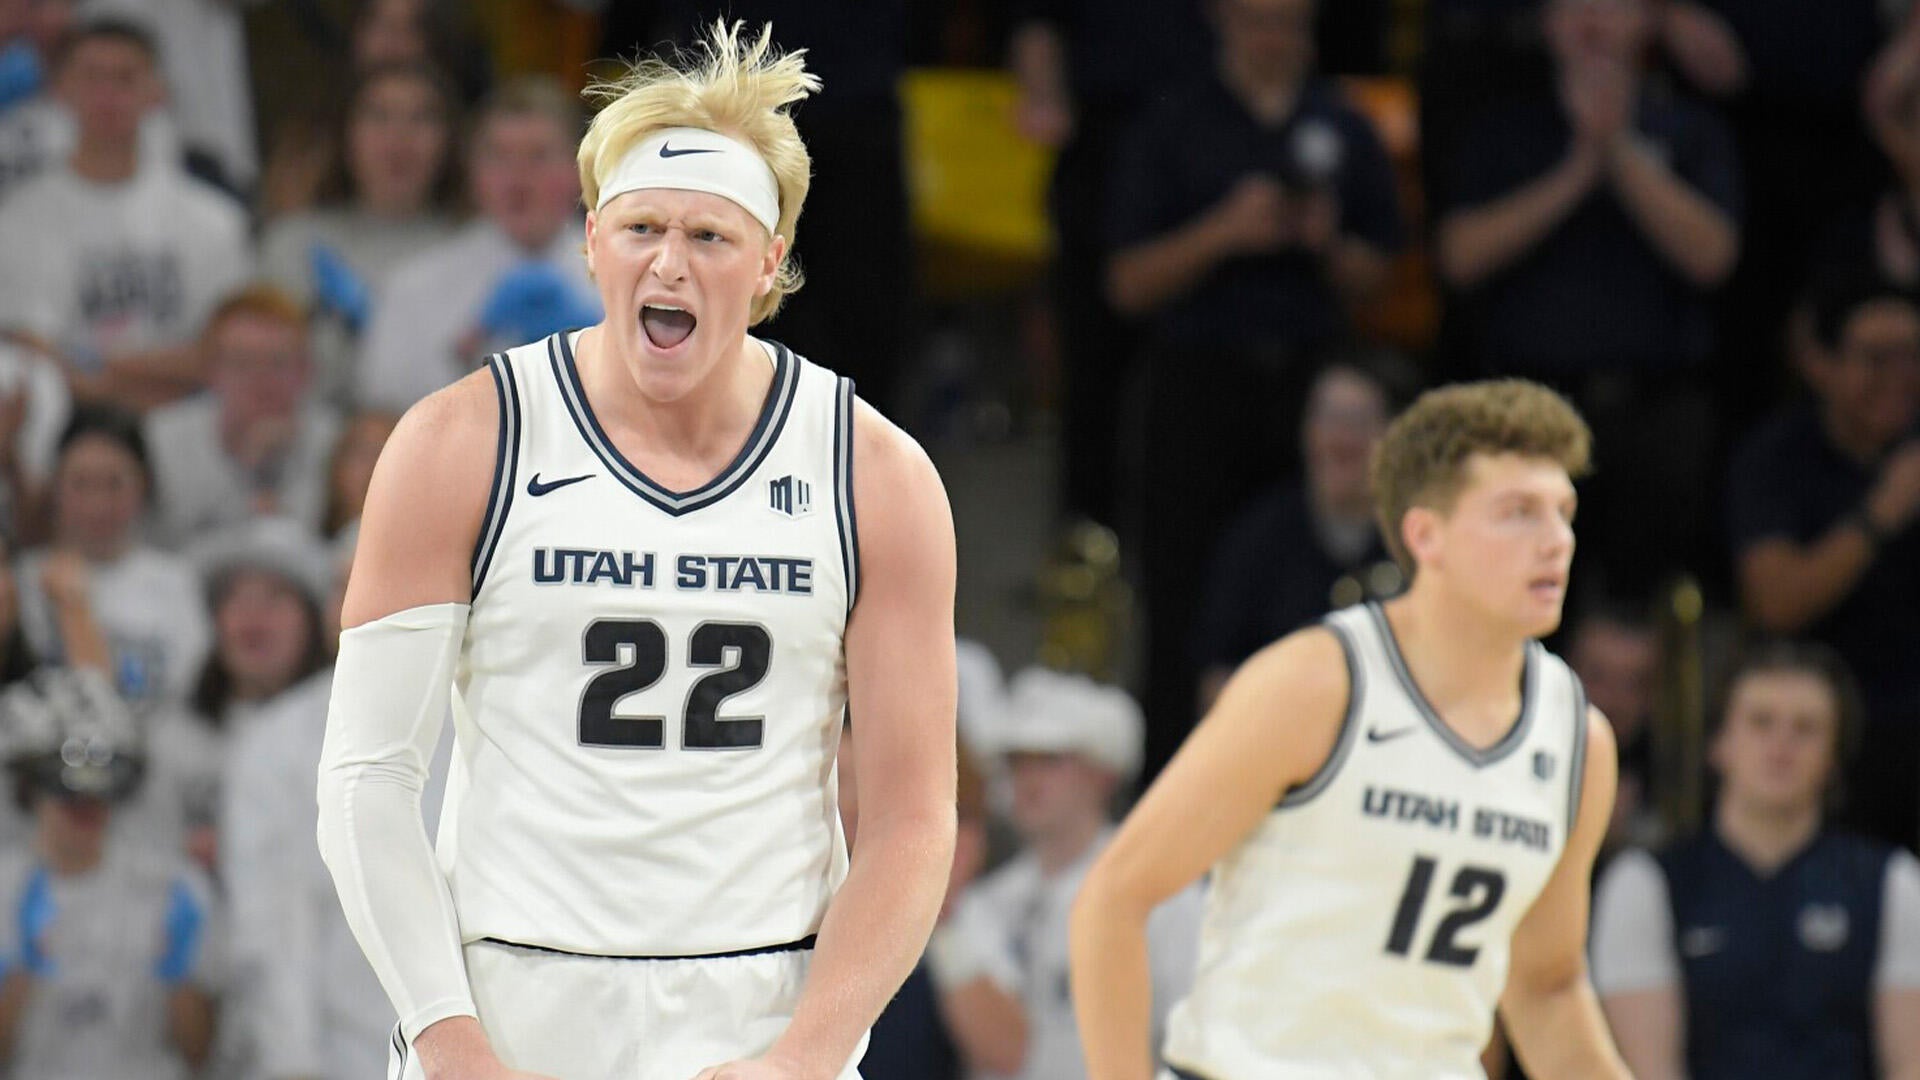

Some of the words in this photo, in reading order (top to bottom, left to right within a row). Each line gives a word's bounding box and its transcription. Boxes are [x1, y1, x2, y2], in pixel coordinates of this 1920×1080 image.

[532, 546, 657, 591] UTAH
[674, 553, 814, 597] STATE
[577, 616, 774, 751] 22
[1362, 785, 1461, 831] UTAH
[1471, 806, 1551, 854] STATE
[1383, 852, 1508, 968] 12
